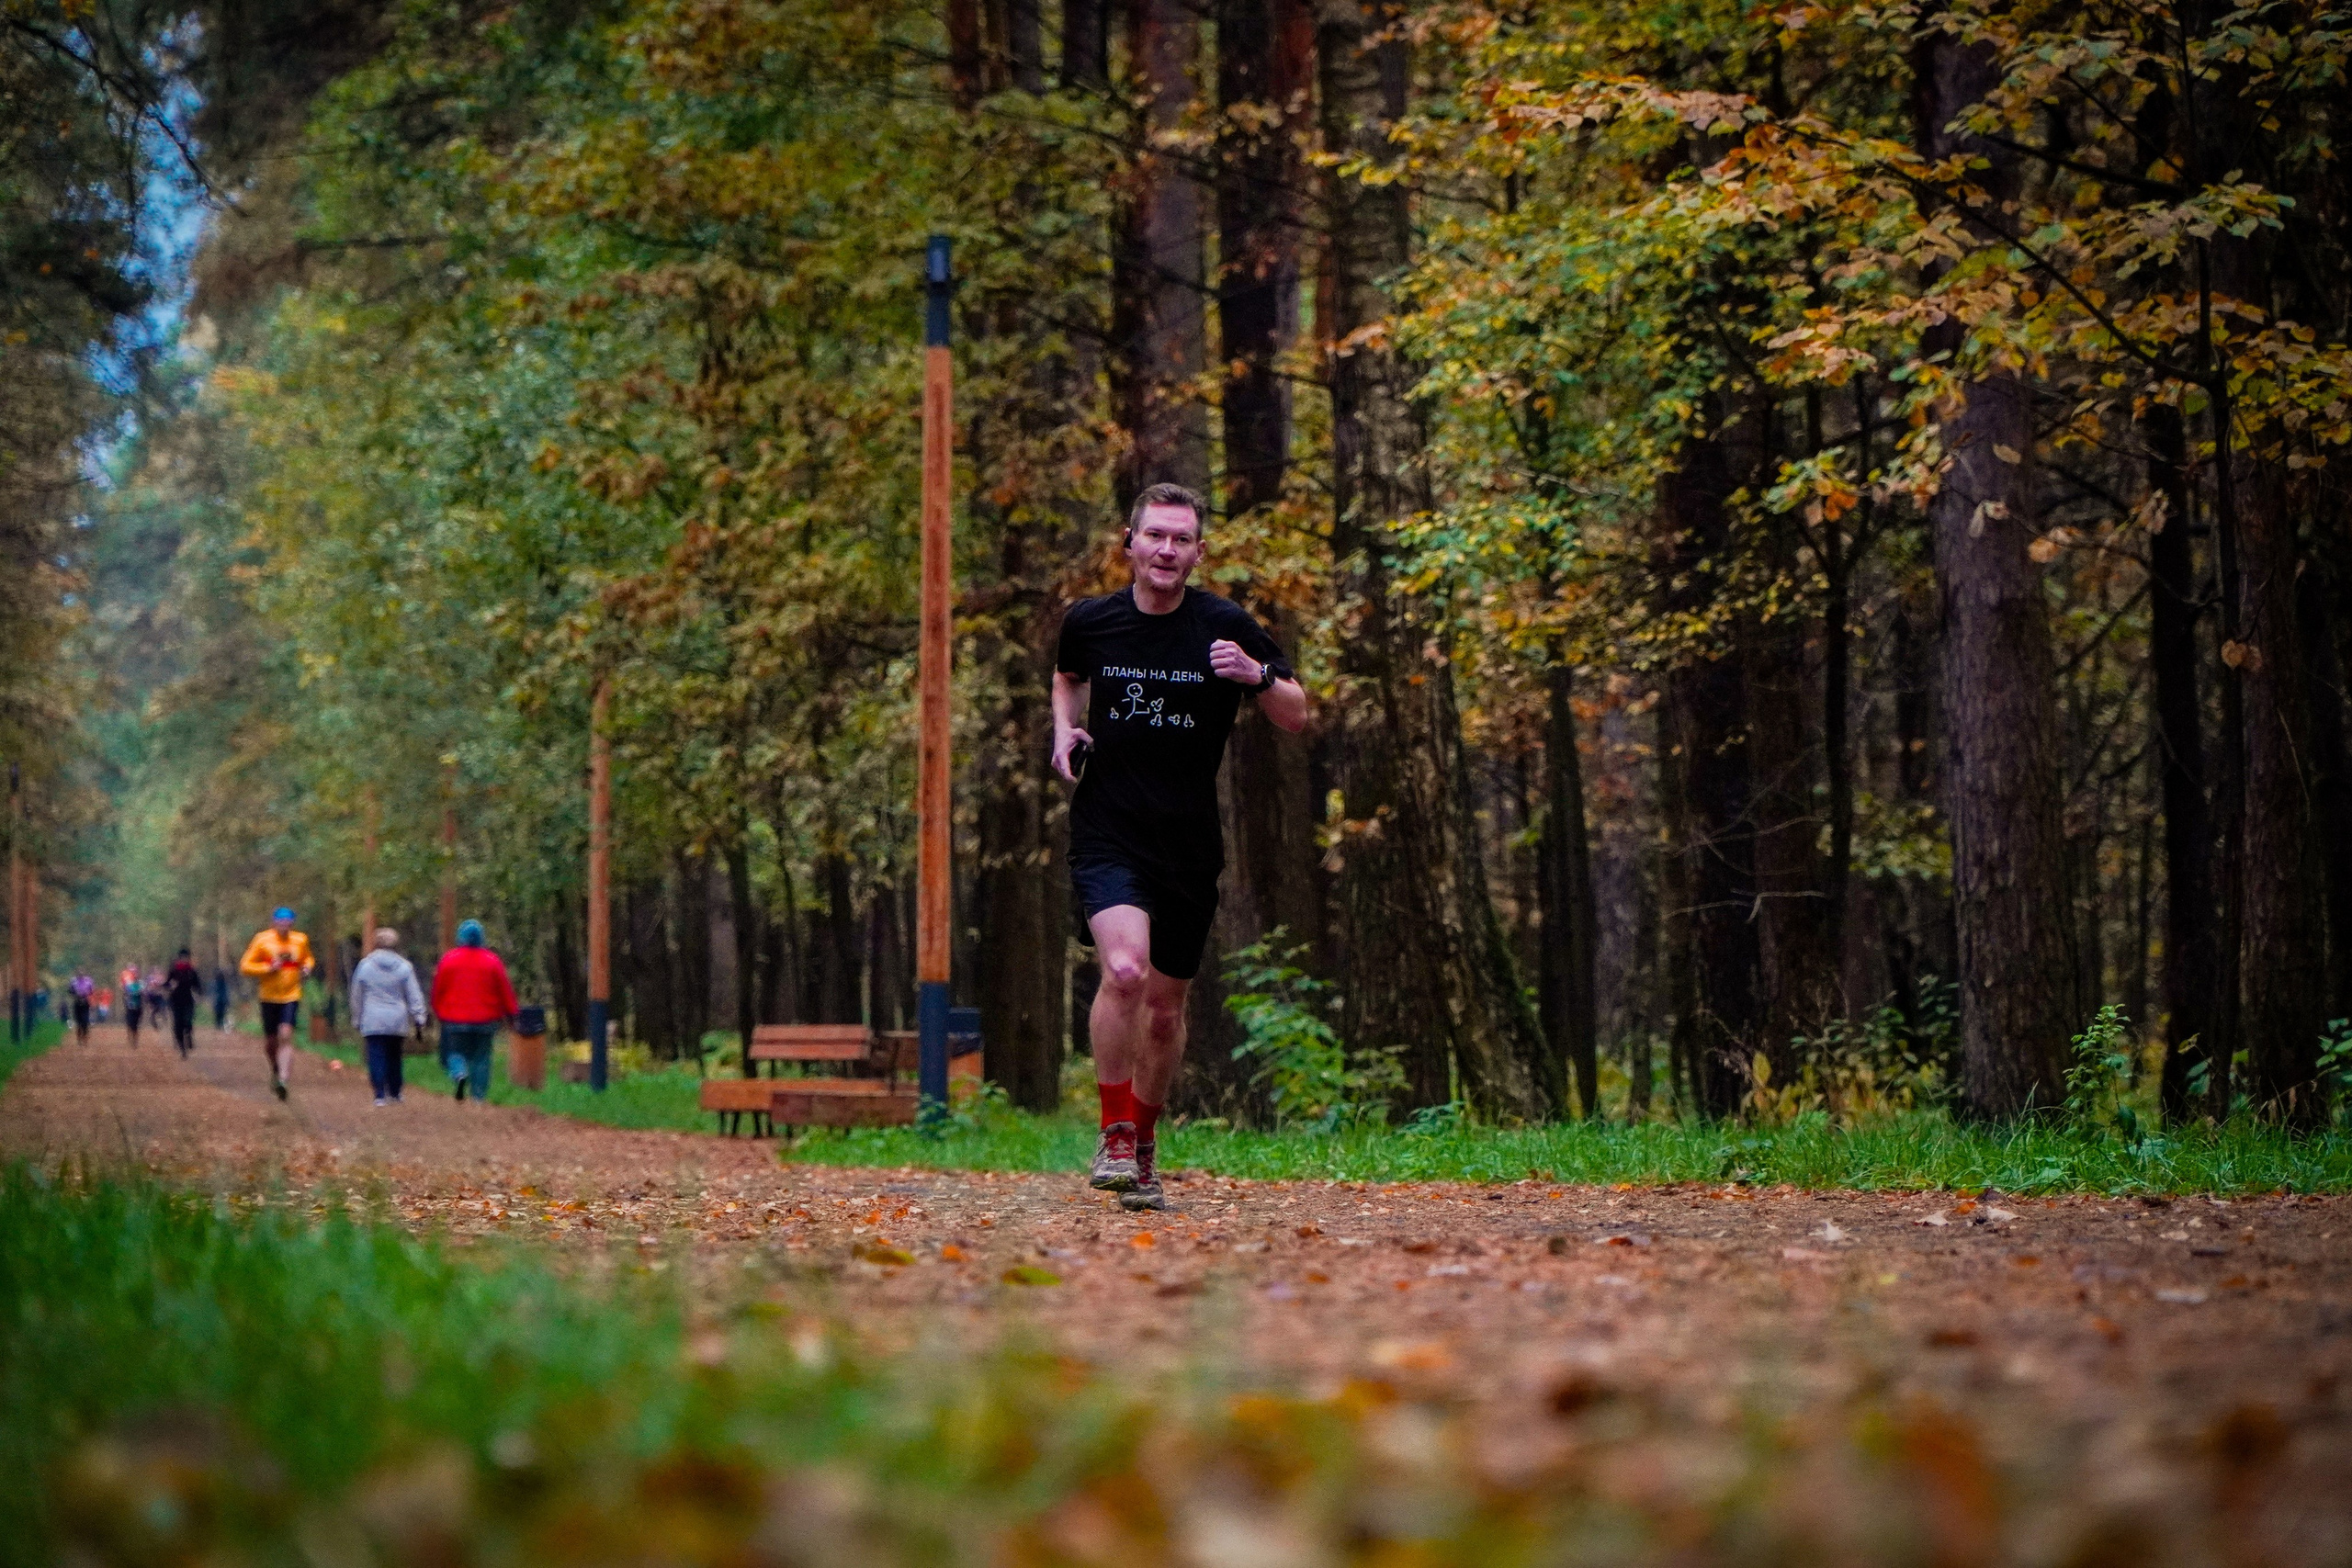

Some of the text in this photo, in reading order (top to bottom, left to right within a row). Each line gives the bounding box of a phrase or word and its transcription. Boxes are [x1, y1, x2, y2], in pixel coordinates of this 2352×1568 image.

[1102, 666, 1204, 682] ПЛАНЫ НА ДЕНЬ
